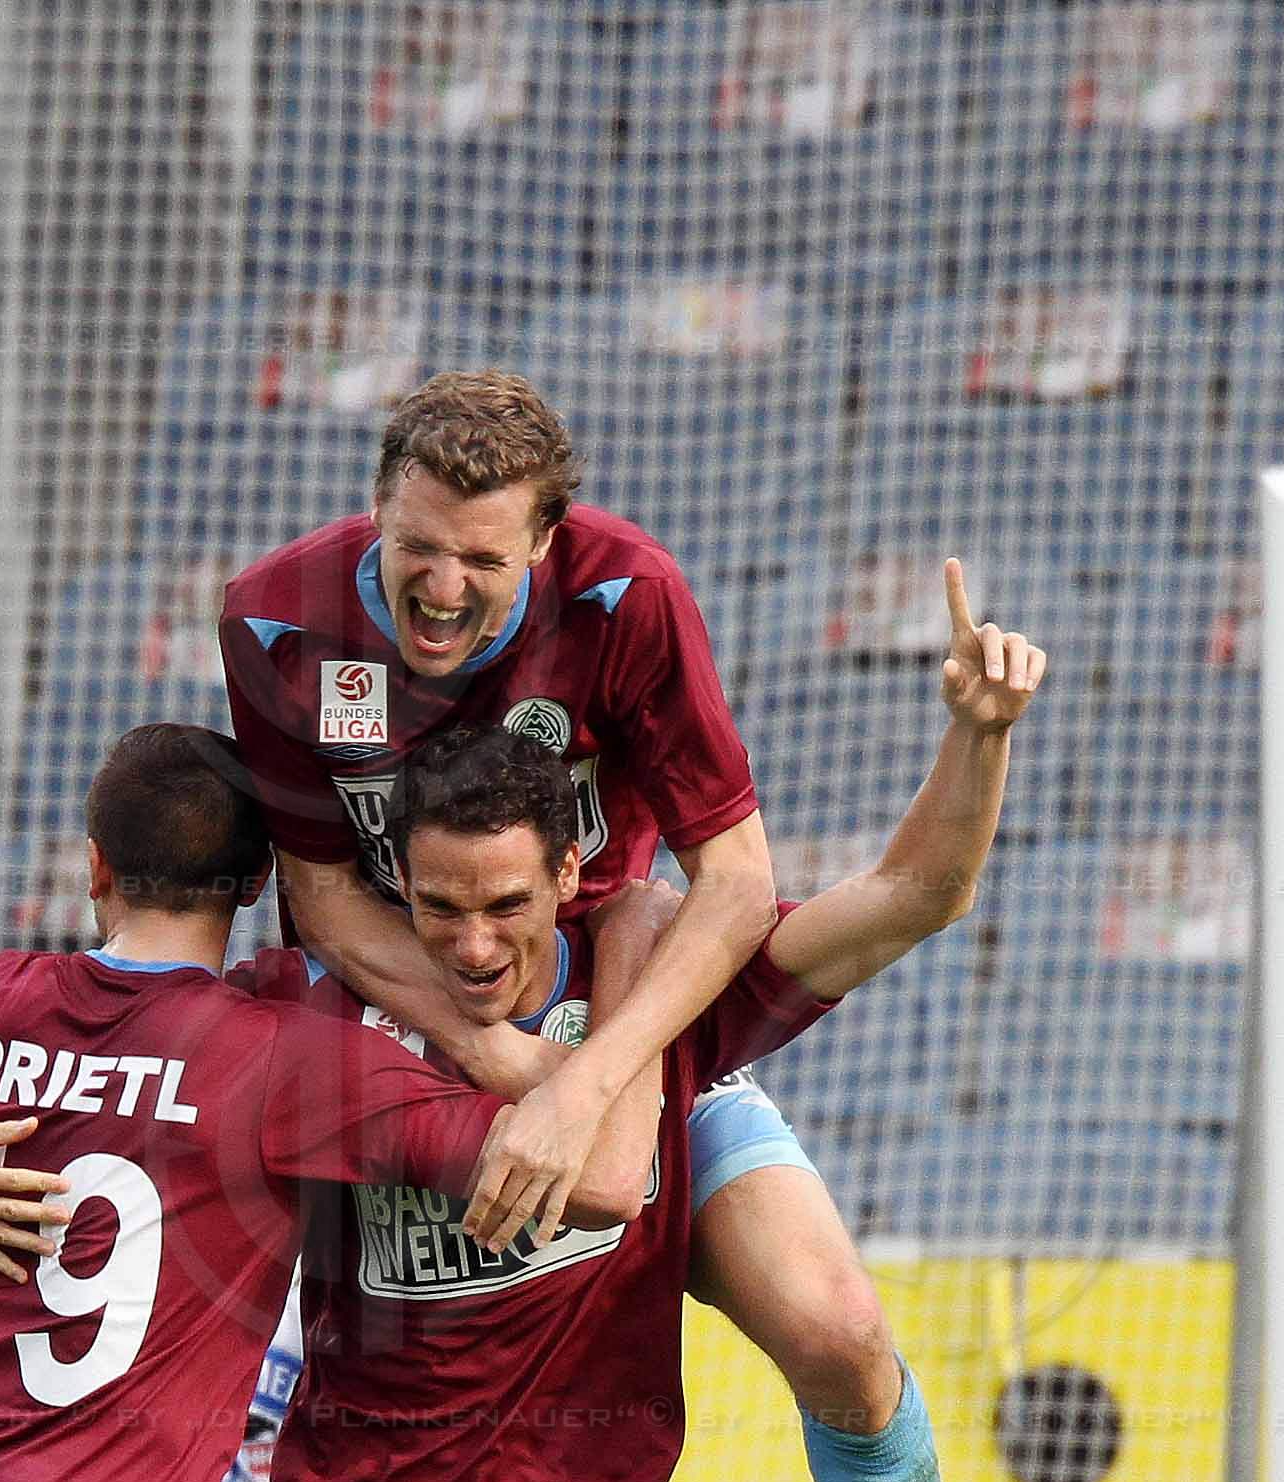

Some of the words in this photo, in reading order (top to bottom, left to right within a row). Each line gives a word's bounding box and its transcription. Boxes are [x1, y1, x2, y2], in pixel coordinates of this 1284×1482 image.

[323, 707, 384, 720] BUNDES
[322, 719, 385, 740] LIGA
[368, 1223, 470, 1283] WELT
